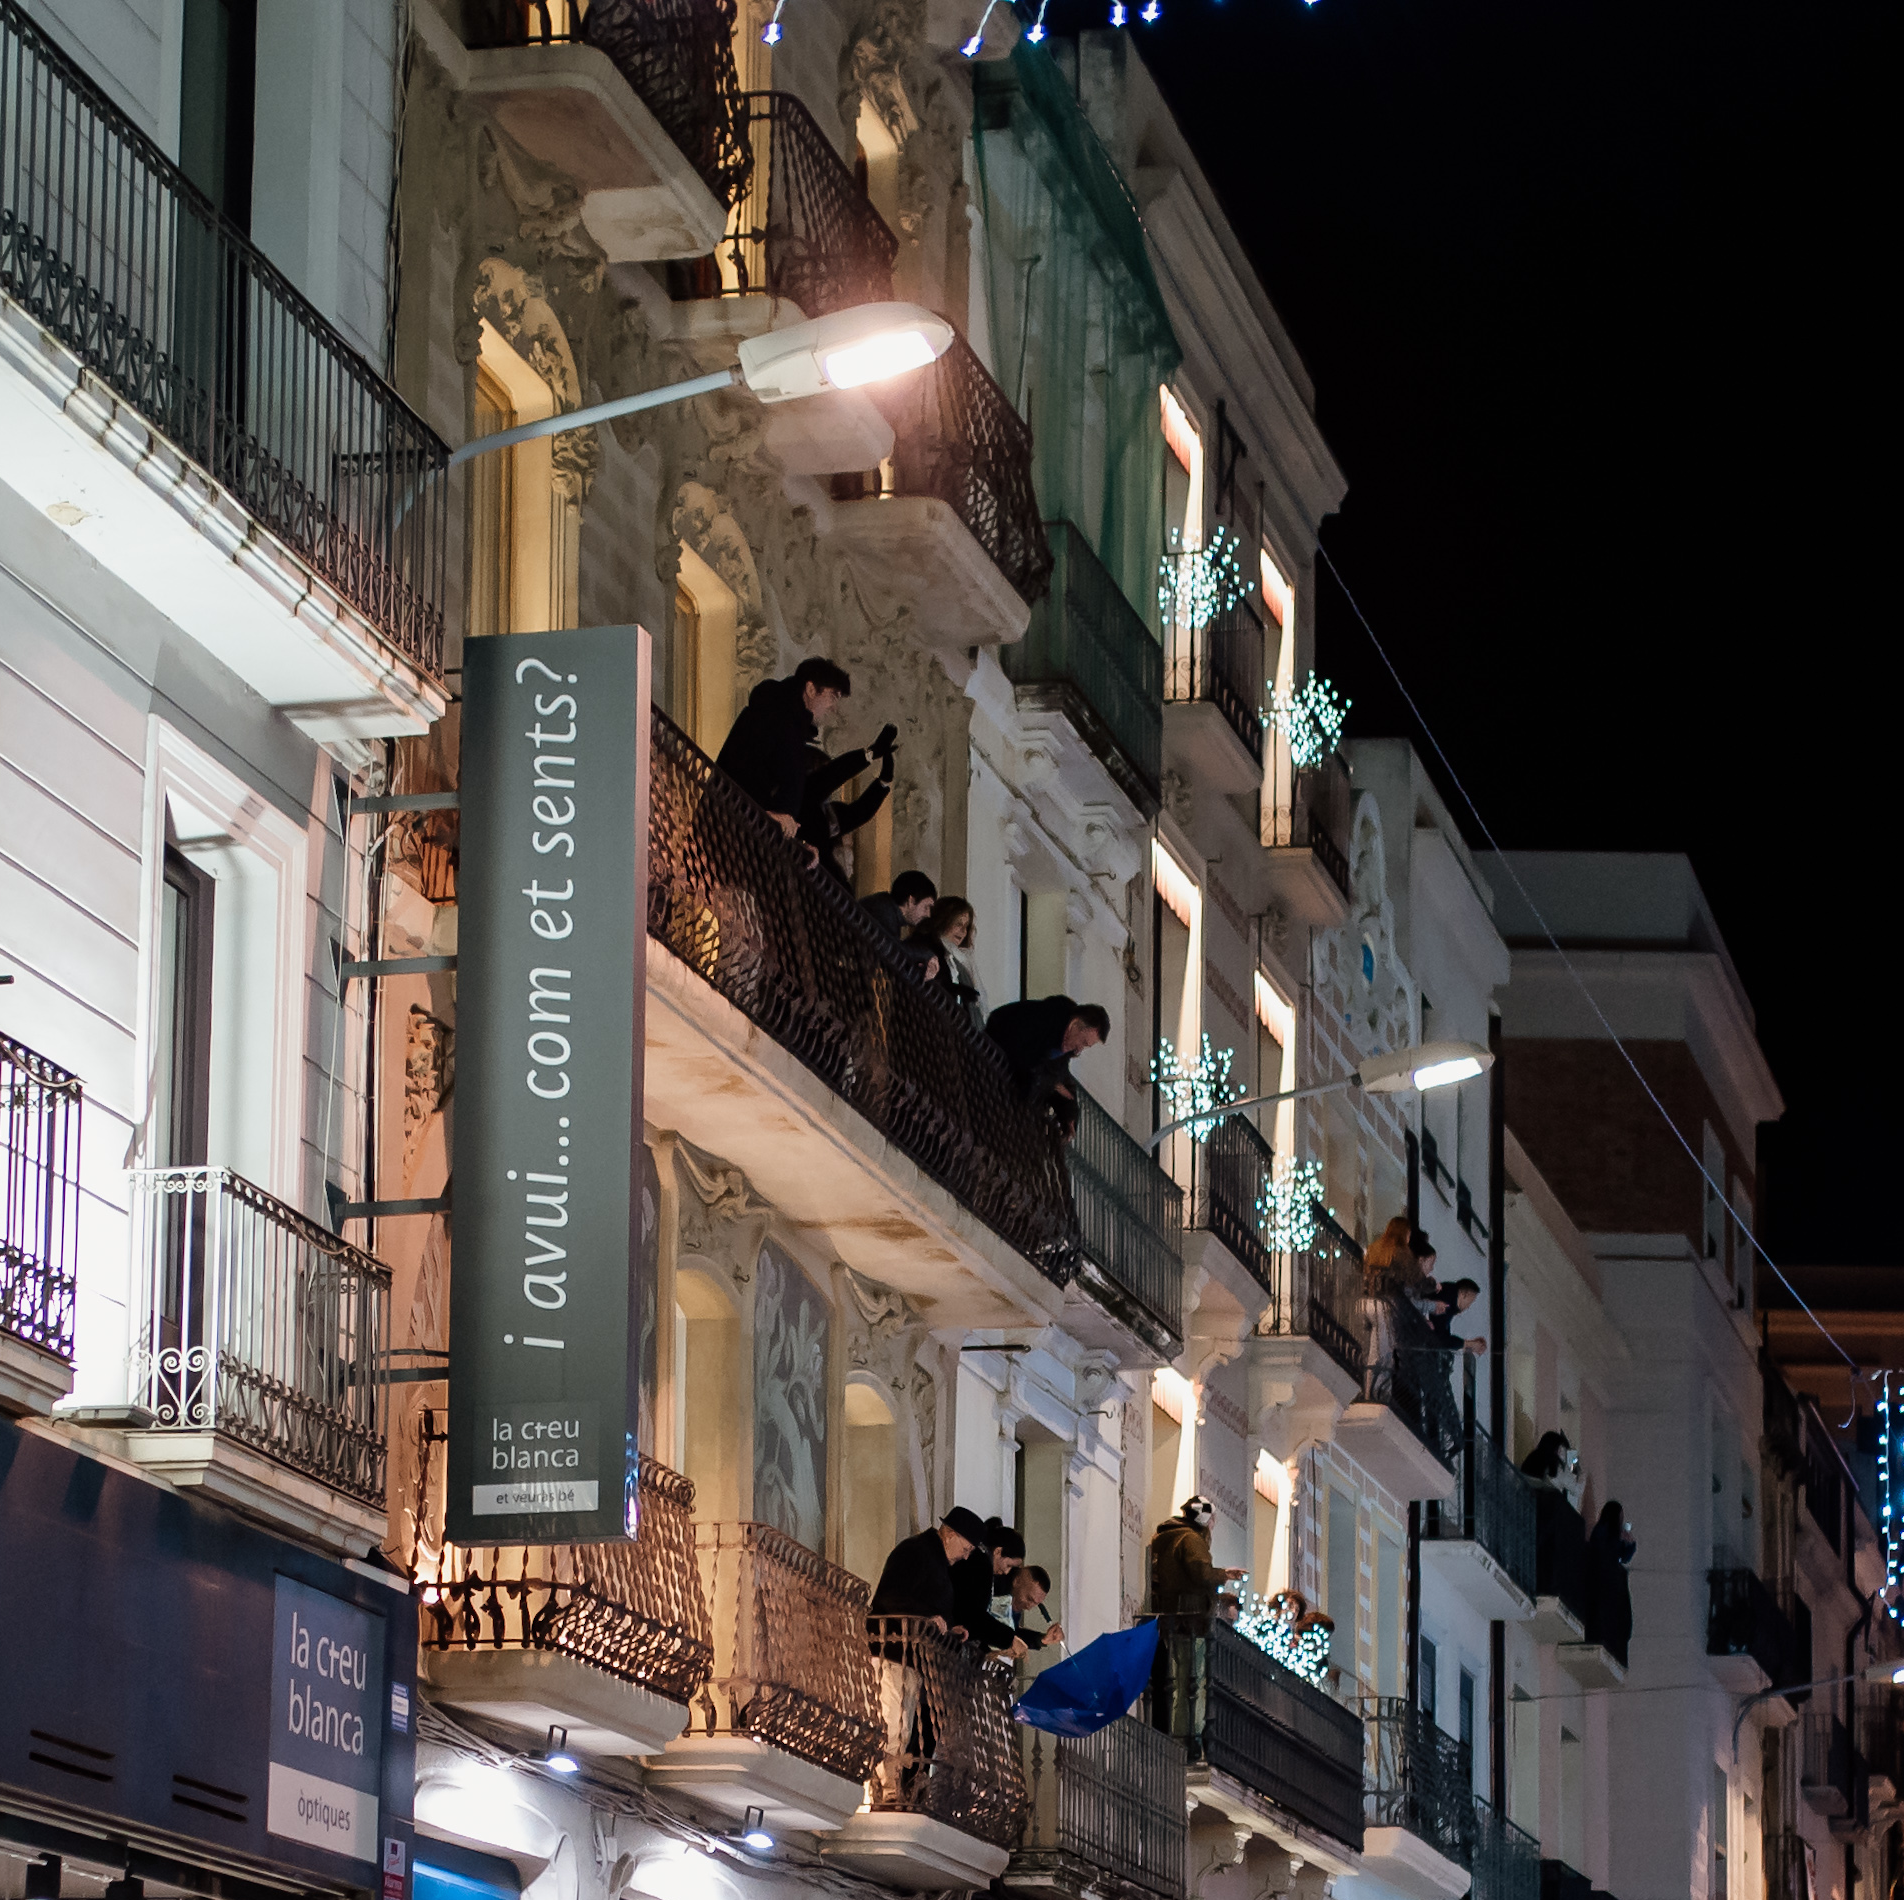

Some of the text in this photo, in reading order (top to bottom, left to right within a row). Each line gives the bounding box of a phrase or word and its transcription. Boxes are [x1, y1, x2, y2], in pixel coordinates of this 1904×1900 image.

[503, 657, 579, 1350] i avui... com et sents?
[492, 1417, 513, 1441] la
[492, 1445, 580, 1470] blanca
[495, 1492, 509, 1505] et
[558, 1488, 576, 1502] bé
[290, 1612, 310, 1670] la
[288, 1678, 364, 1756] blanca
[297, 1788, 351, 1833] òptiques
